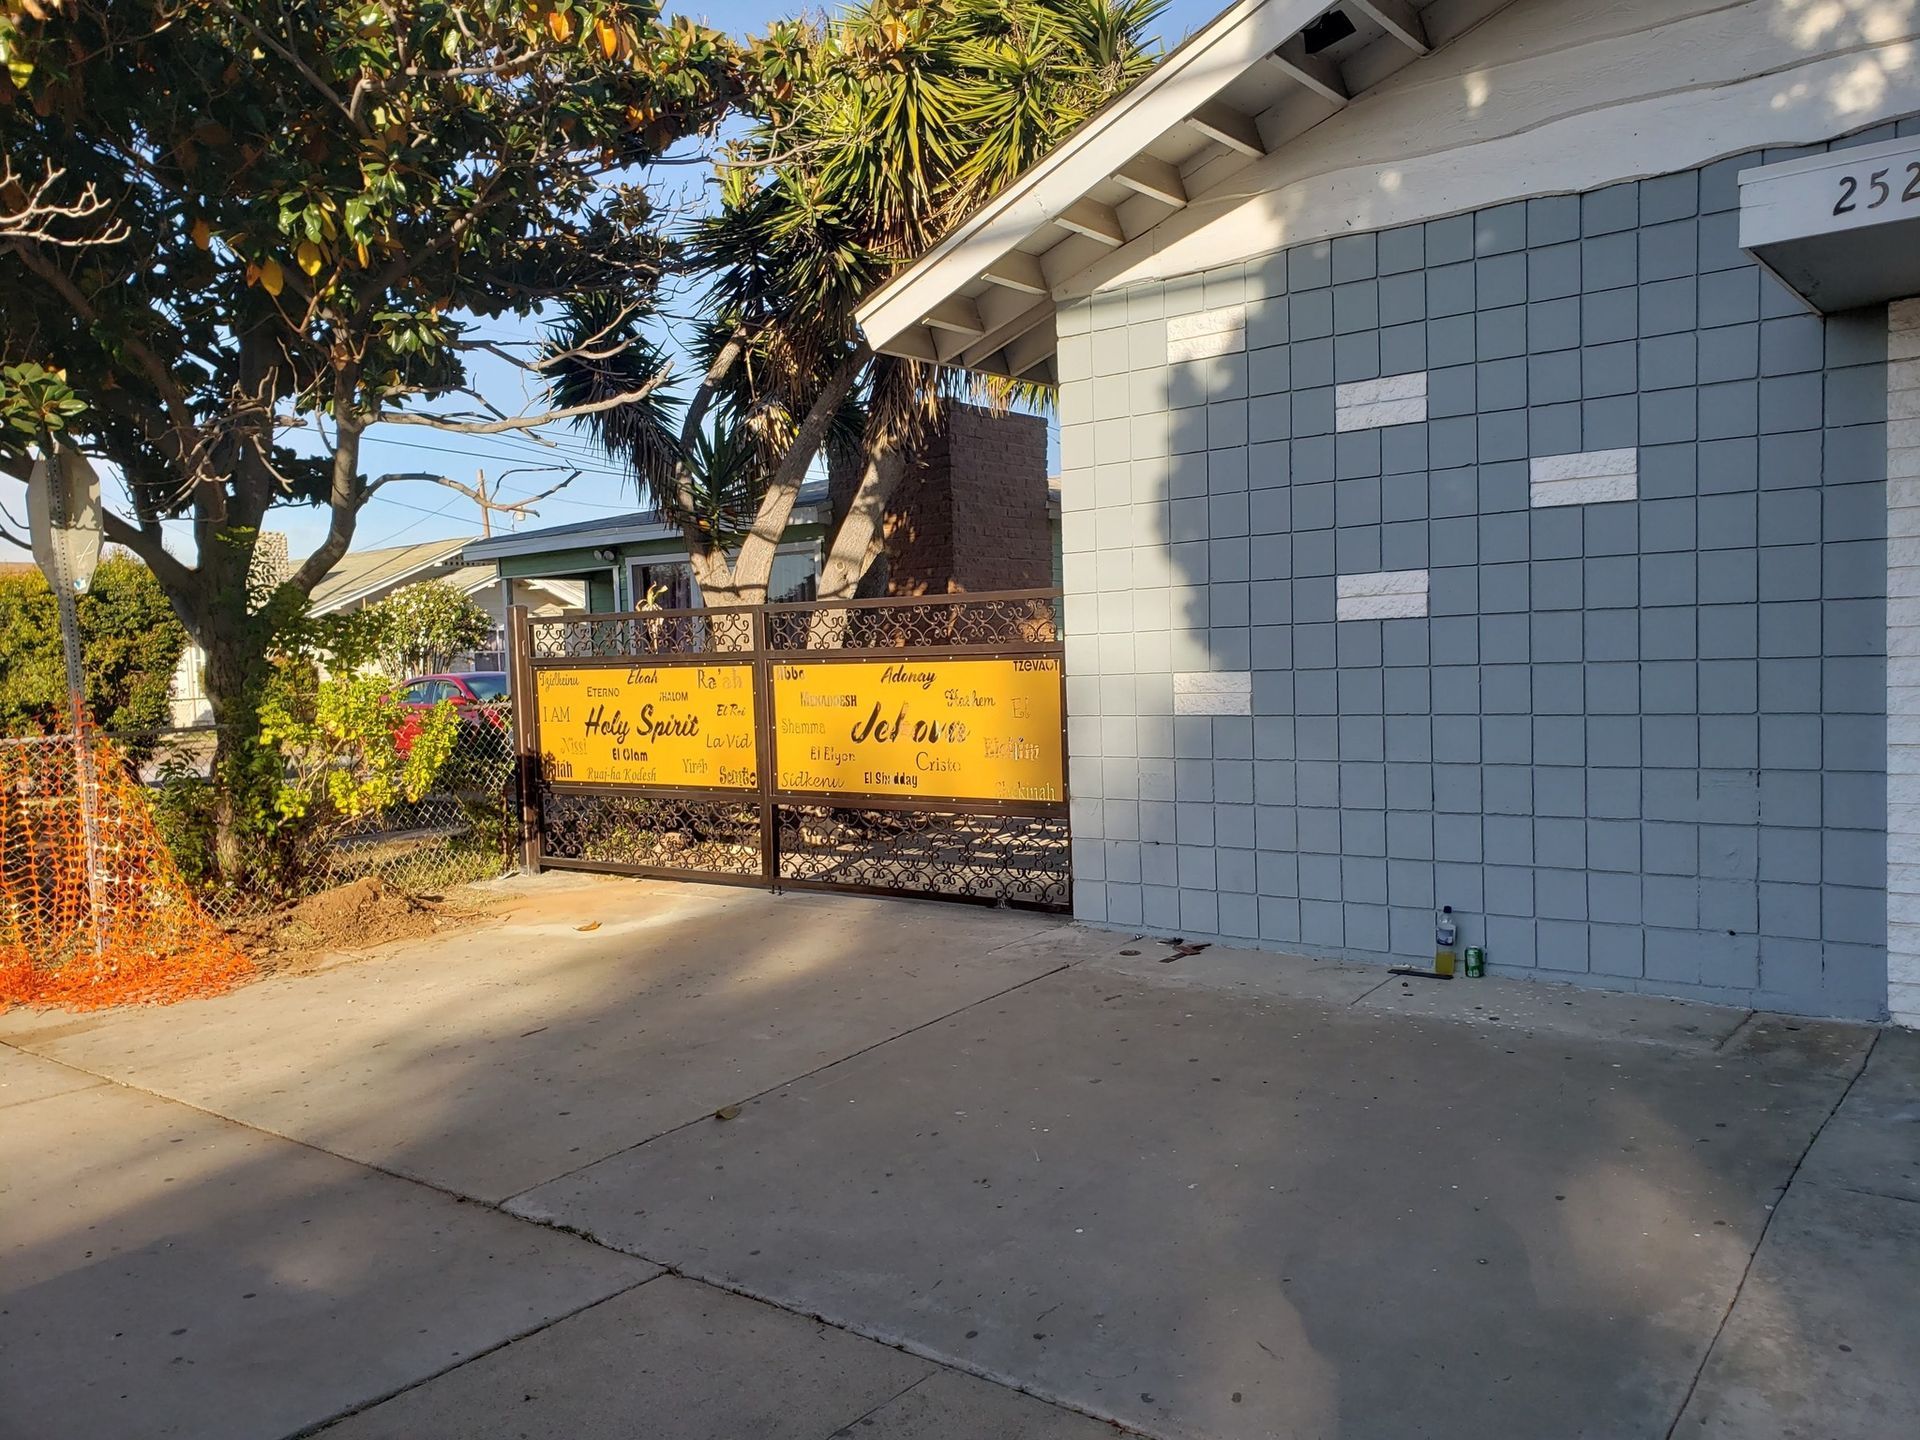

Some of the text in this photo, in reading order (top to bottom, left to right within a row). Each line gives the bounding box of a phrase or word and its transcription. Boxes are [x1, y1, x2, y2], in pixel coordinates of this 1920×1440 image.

[1832, 160, 1920, 216] 252
[626, 667, 658, 685] Eloah
[880, 664, 936, 690] Adonay
[551, 706, 570, 722] AM
[717, 704, 728, 717] El
[584, 703, 699, 744] Holy Spirit
[706, 734, 725, 749] La
[612, 748, 648, 762] El Olam
[916, 751, 961, 772] Cristo
[864, 772, 873, 785] El
